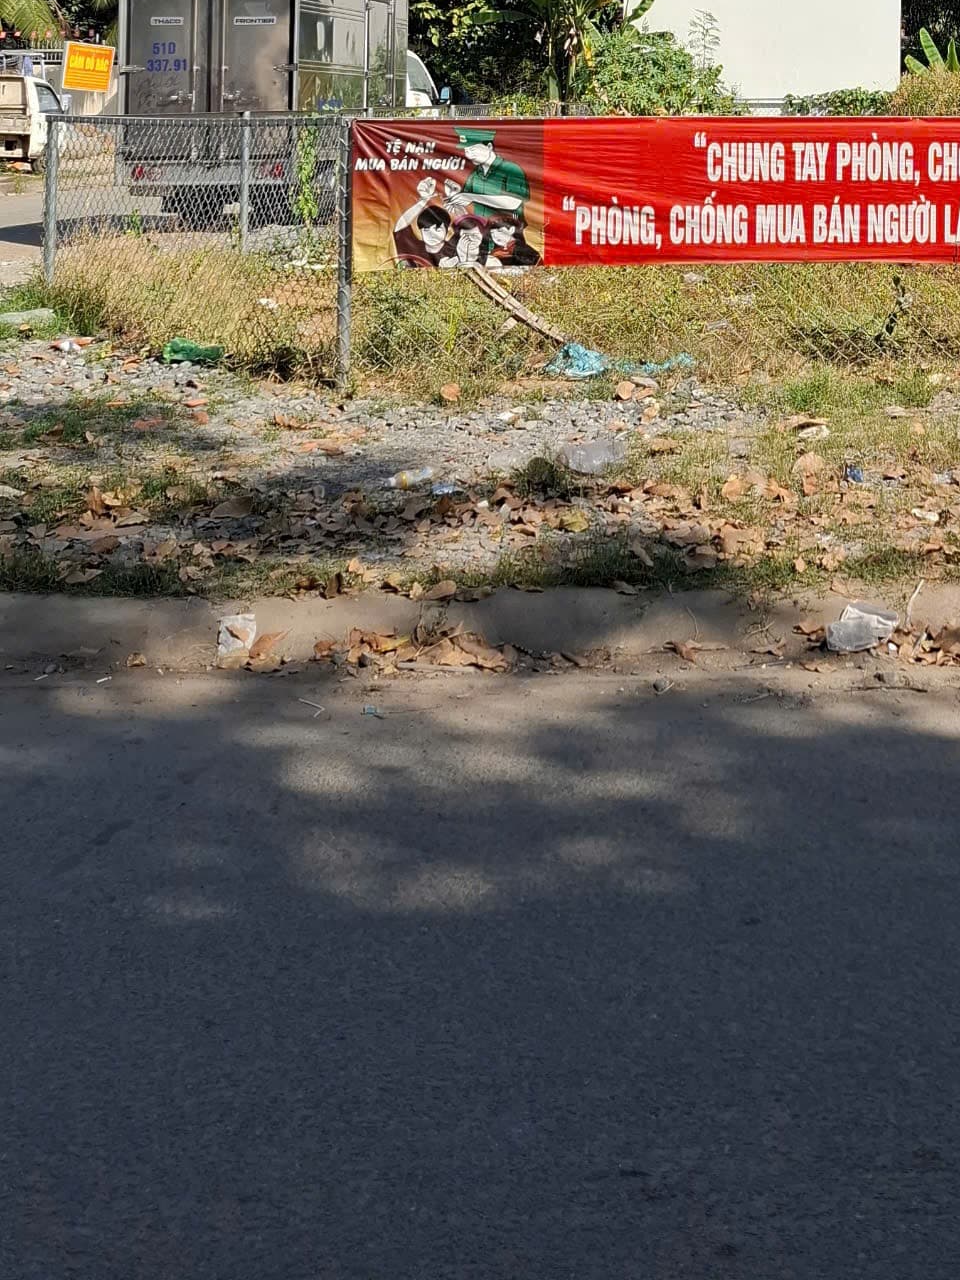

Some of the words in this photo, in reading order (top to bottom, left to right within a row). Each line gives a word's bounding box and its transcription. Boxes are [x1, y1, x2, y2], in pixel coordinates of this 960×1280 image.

[152, 41, 177, 55] 51D
[146, 58, 188, 73] 337.91
[386, 139, 402, 155] TỆ
[405, 142, 436, 155] NẠN
[354, 157, 386, 171] MUA
[390, 155, 419, 171] BÁN
[791, 142, 830, 182] TAY
[836, 132, 921, 187] PHÒNG,
[669, 191, 749, 245] CHỐNG
[755, 204, 806, 244] MUA
[813, 195, 861, 244] BÁN
[867, 195, 937, 244] NGƯỜI
